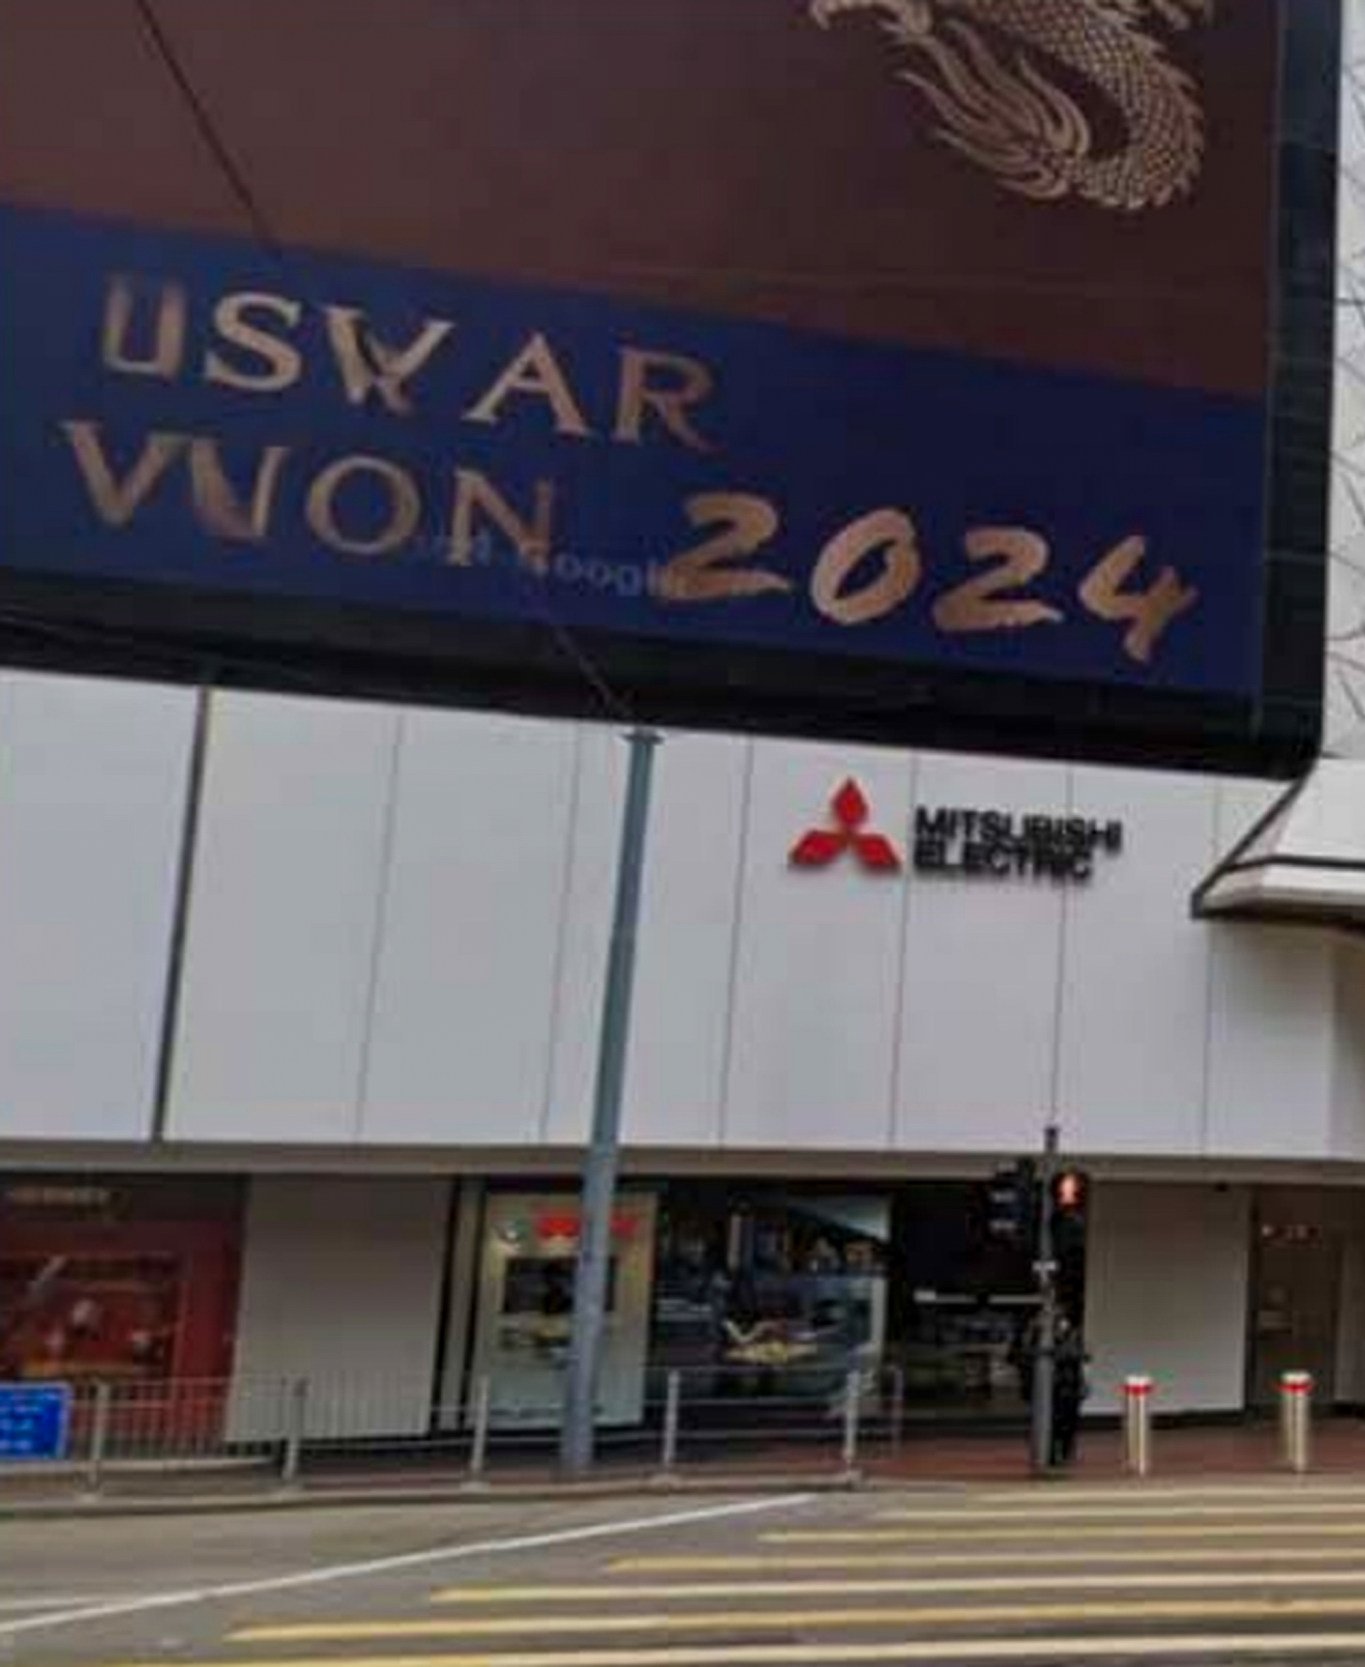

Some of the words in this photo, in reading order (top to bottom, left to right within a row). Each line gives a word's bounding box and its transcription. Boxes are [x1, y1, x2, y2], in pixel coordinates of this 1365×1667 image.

[655, 490, 1200, 665] 2024
[914, 806, 1123, 853] MITSUBISHI
[914, 838, 1093, 882] ELECTRIC
